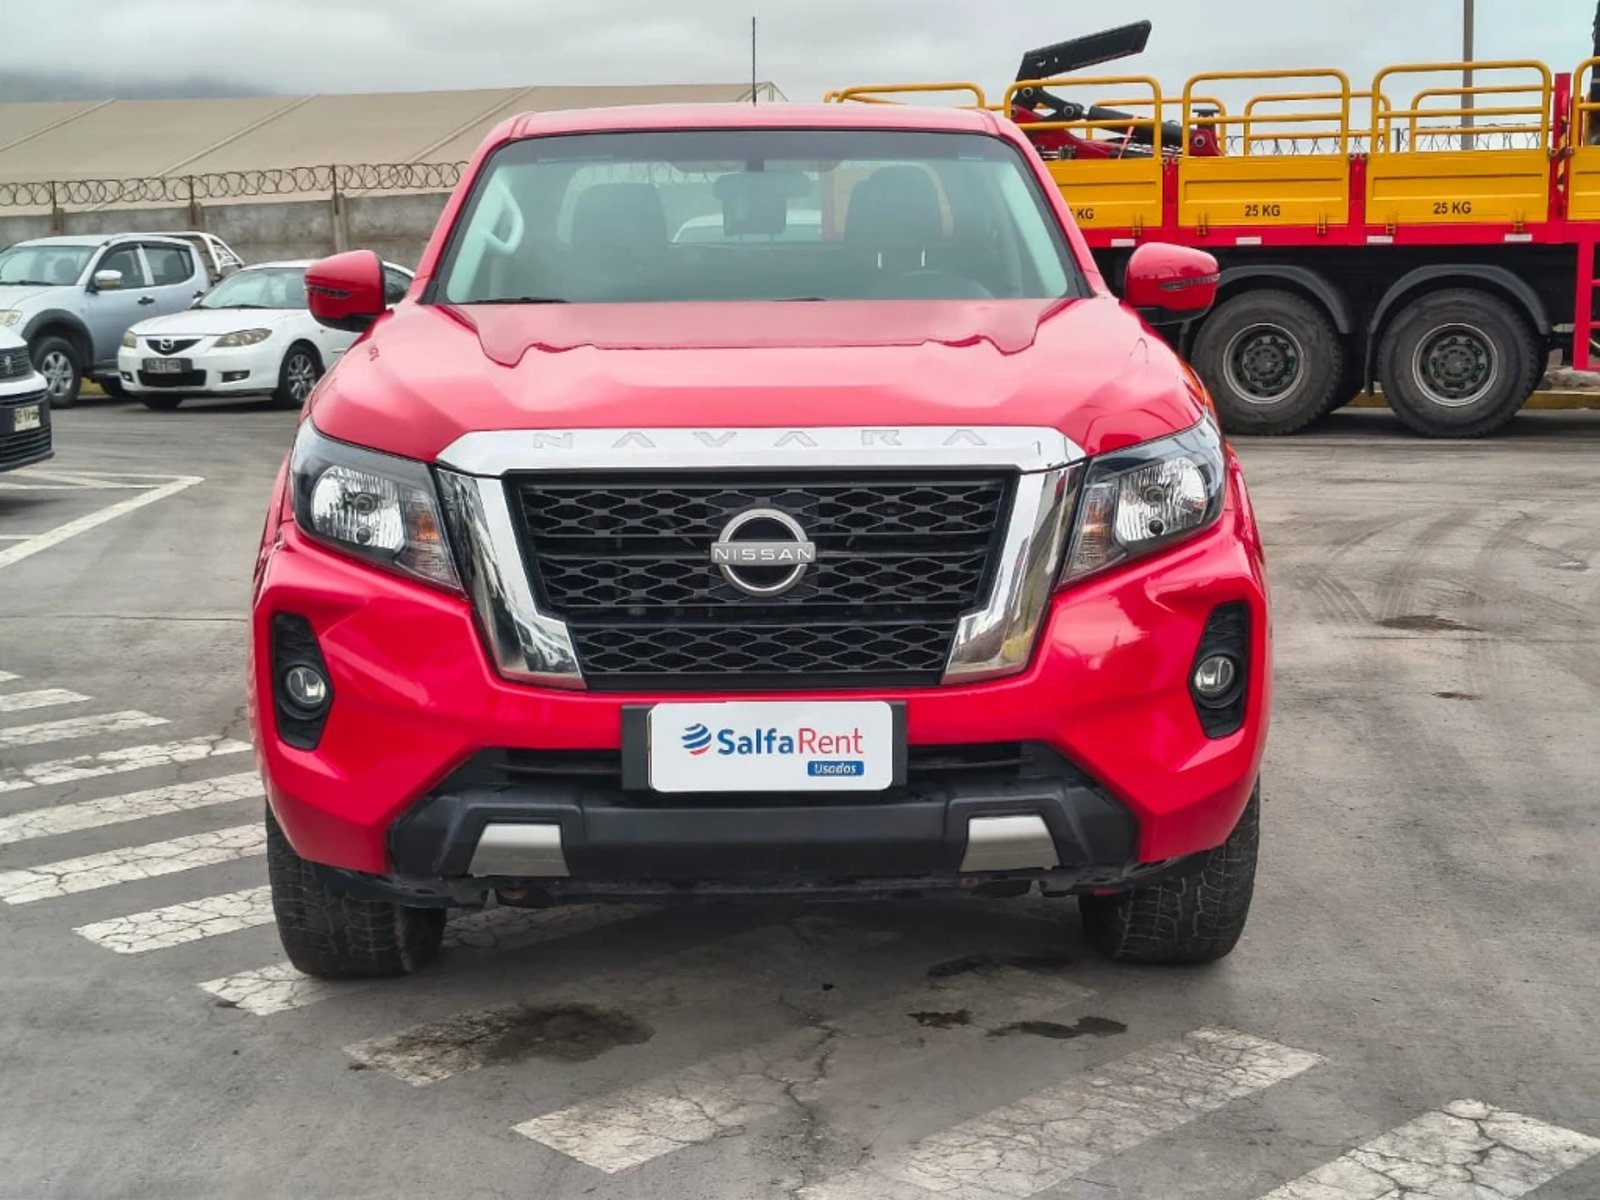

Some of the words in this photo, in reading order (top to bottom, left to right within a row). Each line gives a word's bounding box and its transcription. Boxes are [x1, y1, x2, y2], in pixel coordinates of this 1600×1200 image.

[1077, 207, 1095, 220] KG
[1244, 204, 1259, 217] 25
[1262, 204, 1281, 217] KG
[1433, 202, 1448, 215] 25
[1452, 201, 1472, 215] KG
[533, 429, 988, 449] NAVARA
[714, 547, 813, 560] NISSAN
[717, 727, 864, 756] SalfaRent
[814, 762, 857, 775] Usados
